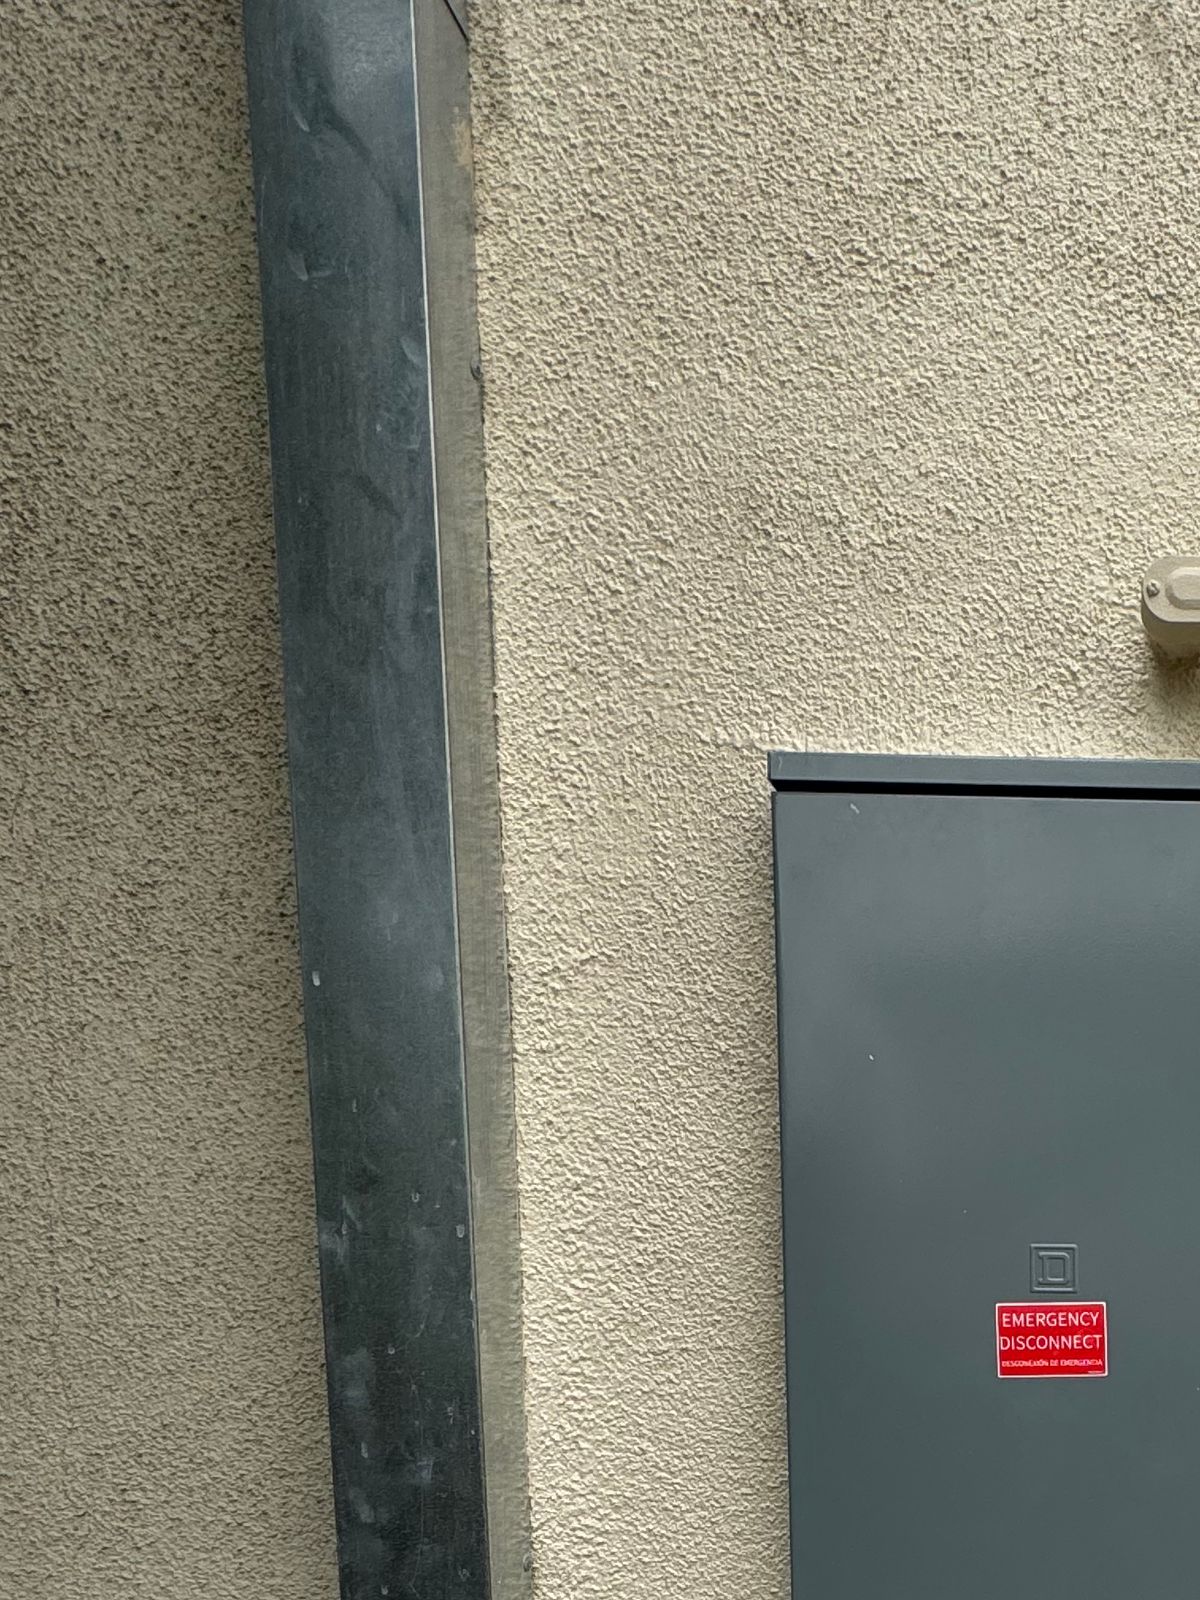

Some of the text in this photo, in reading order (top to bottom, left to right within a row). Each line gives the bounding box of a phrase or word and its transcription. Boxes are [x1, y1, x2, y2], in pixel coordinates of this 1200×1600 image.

[1002, 1311, 1099, 1327] EMERGENCY
[1000, 1334, 1102, 1350] DISCONNECT
[1050, 1359, 1058, 1367] DE
